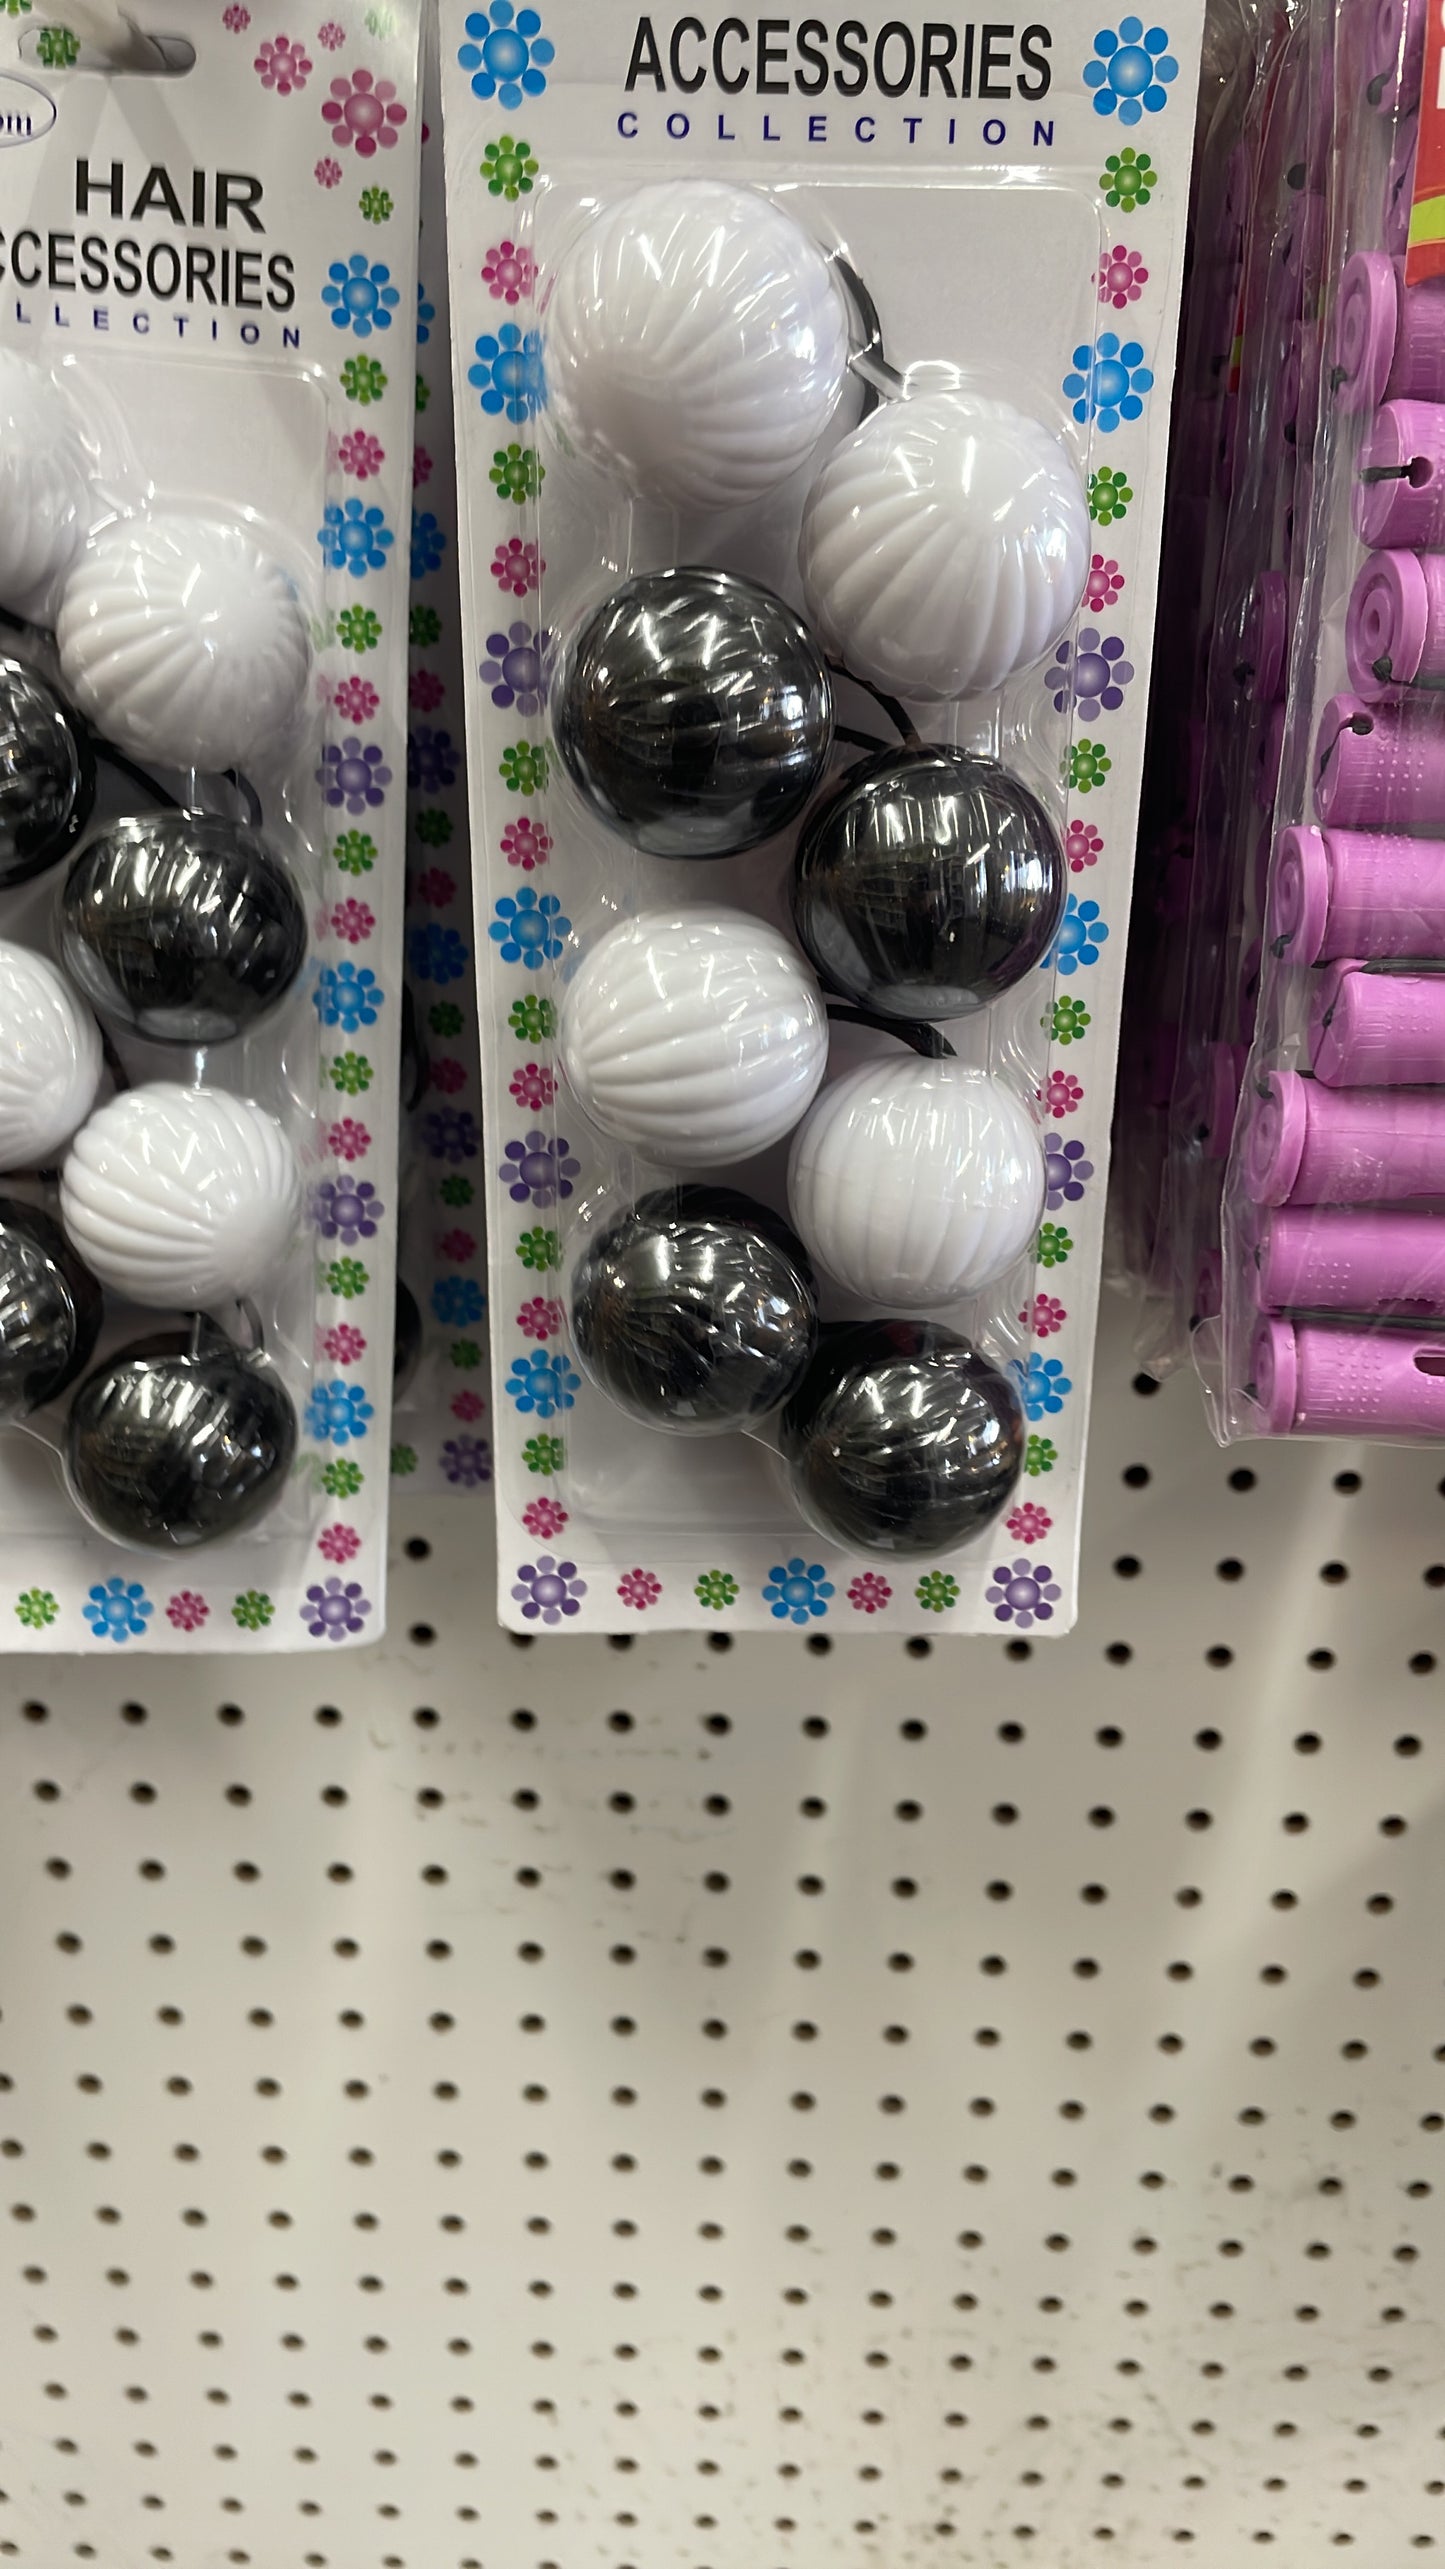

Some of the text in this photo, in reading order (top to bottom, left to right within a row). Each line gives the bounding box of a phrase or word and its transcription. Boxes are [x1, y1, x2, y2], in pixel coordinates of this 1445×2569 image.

[624, 16, 1053, 101] ACCESSORIES
[616, 111, 1055, 147] COLLECTION
[75, 158, 267, 234] HAIR
[0, 229, 296, 313] CESSORIES
